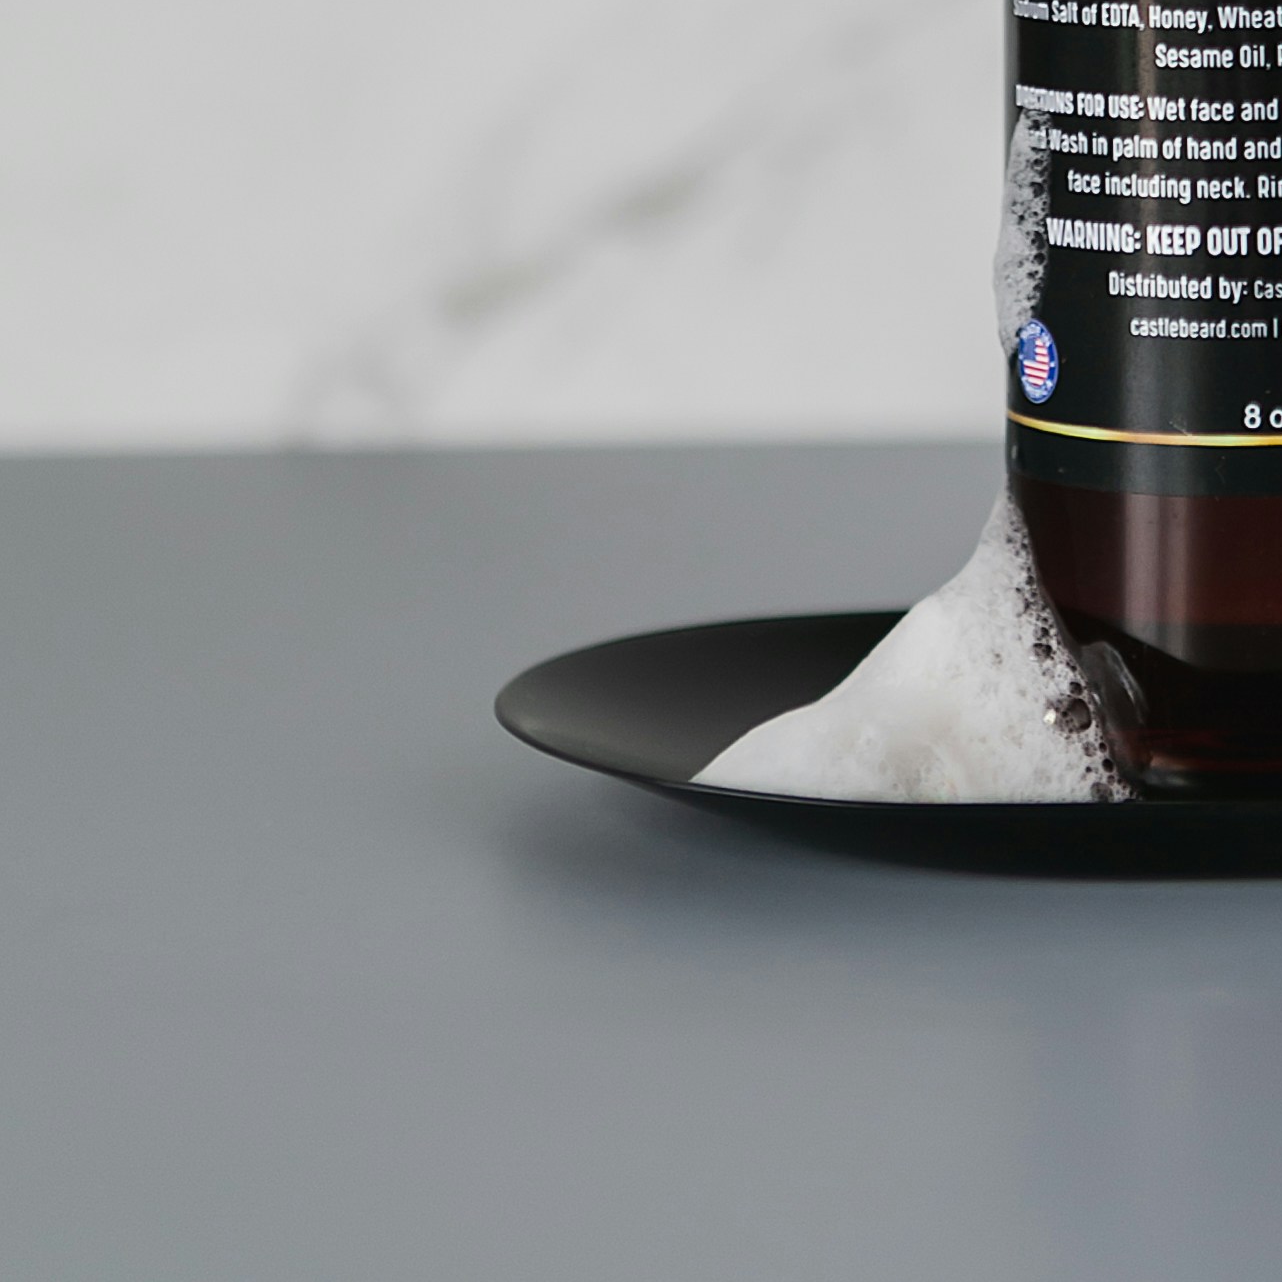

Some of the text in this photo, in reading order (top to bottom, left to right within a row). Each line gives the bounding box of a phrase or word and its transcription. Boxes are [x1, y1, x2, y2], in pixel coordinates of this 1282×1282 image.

[1052, 0, 1078, 24] Salt
[1082, 3, 1098, 25] of
[1102, 2, 1145, 31] EDTA,
[1149, 5, 1213, 34] Honey,
[1155, 43, 1233, 68] Sesame
[1239, 45, 1271, 70] Oil,
[1077, 93, 1105, 118] FOR
[1109, 95, 1144, 120] USE:
[1147, 97, 1186, 121] Wet
[1190, 99, 1234, 121] face
[1241, 99, 1278, 120] and
[1049, 129, 1088, 154] Wash
[1092, 132, 1108, 155] in
[1112, 135, 1158, 161] palm
[1162, 137, 1182, 160] of
[1187, 137, 1237, 160] hand
[1244, 138, 1282, 160] and
[1067, 170, 1101, 194] face
[1105, 172, 1192, 205] including
[1196, 177, 1251, 199] neck.
[1046, 218, 1141, 254] WARNING:
[1146, 225, 1200, 255] KEEP
[1207, 227, 1251, 256] OUT
[1109, 271, 1213, 300] Distributed
[1219, 276, 1248, 304] by:
[1130, 317, 1267, 339] castlebeard.com
[1243, 402, 1261, 429] 8
